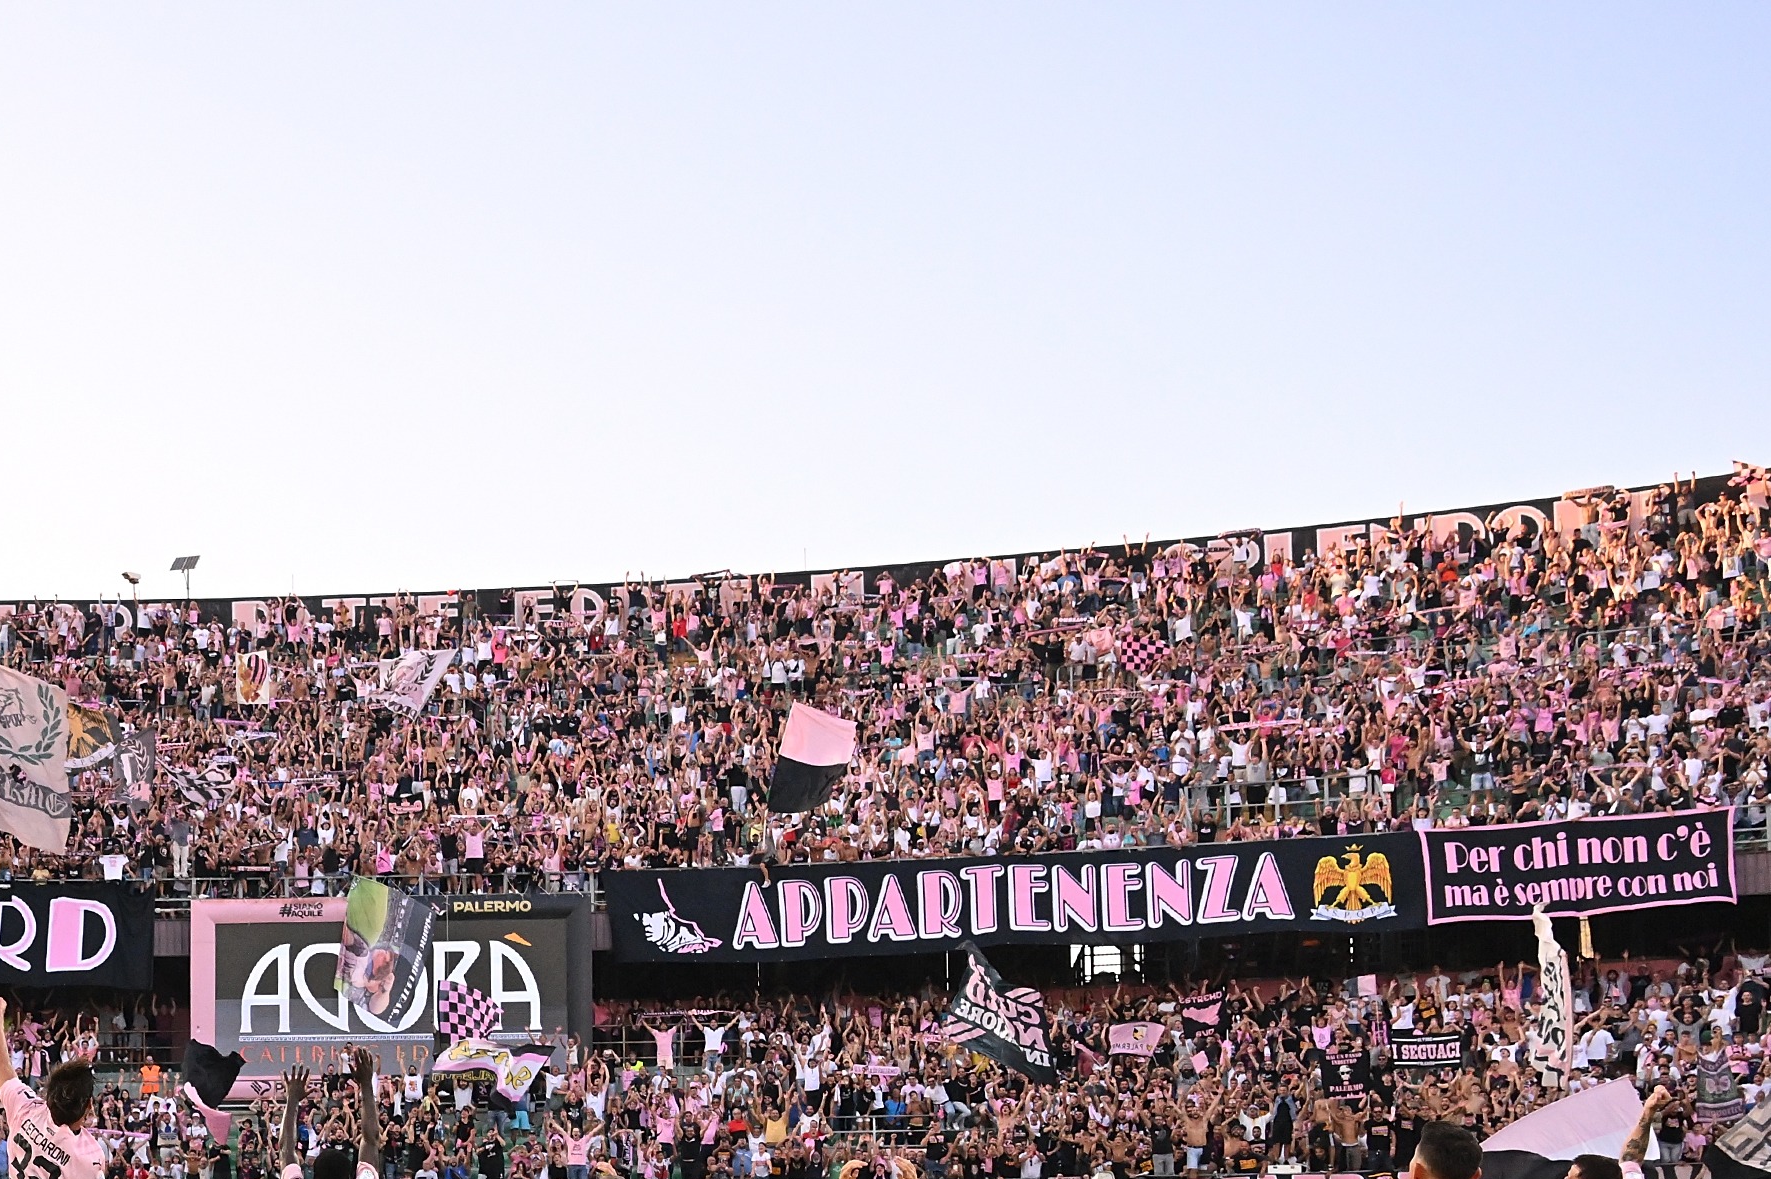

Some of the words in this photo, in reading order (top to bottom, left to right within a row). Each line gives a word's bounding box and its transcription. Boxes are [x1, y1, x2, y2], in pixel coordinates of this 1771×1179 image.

[1443, 840, 1506, 873] Per
[1513, 832, 1569, 871] chi
[1578, 834, 1648, 866] non
[1444, 880, 1490, 909] ma
[1494, 877, 1510, 906] è
[1513, 870, 1612, 908] sempre
[1617, 872, 1668, 898] con
[1672, 862, 1718, 893] noi
[453, 900, 532, 914] PALERMO
[732, 852, 1296, 951] APPARTENENZA
[291, 909, 323, 918] AQUILE
[1392, 1044, 1398, 1060] I
[1401, 1042, 1461, 1060] SEGUACI
[1329, 1083, 1364, 1092] PALERMO
